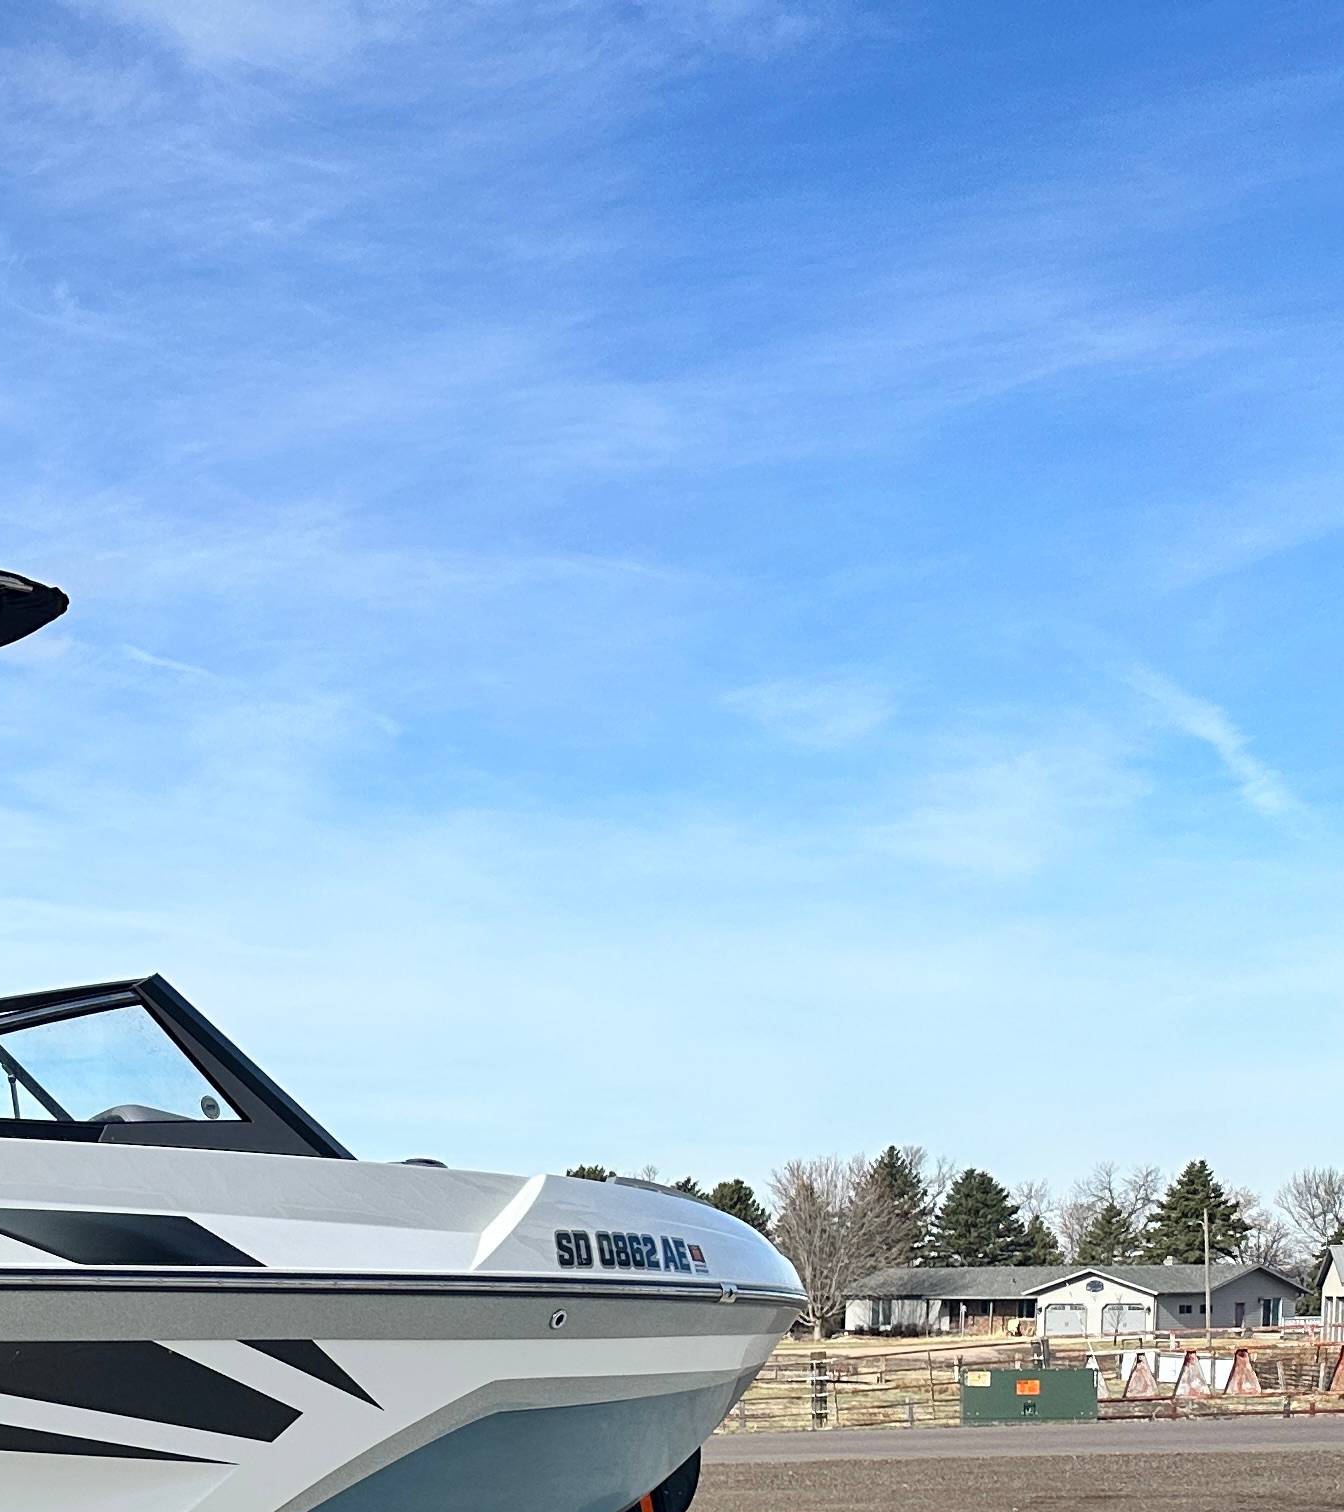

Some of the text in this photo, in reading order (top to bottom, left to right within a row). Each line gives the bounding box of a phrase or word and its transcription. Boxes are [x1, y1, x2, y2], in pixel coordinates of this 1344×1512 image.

[555, 1230, 593, 1269] SD
[596, 1231, 661, 1271] 0862
[660, 1236, 692, 1274] AE
